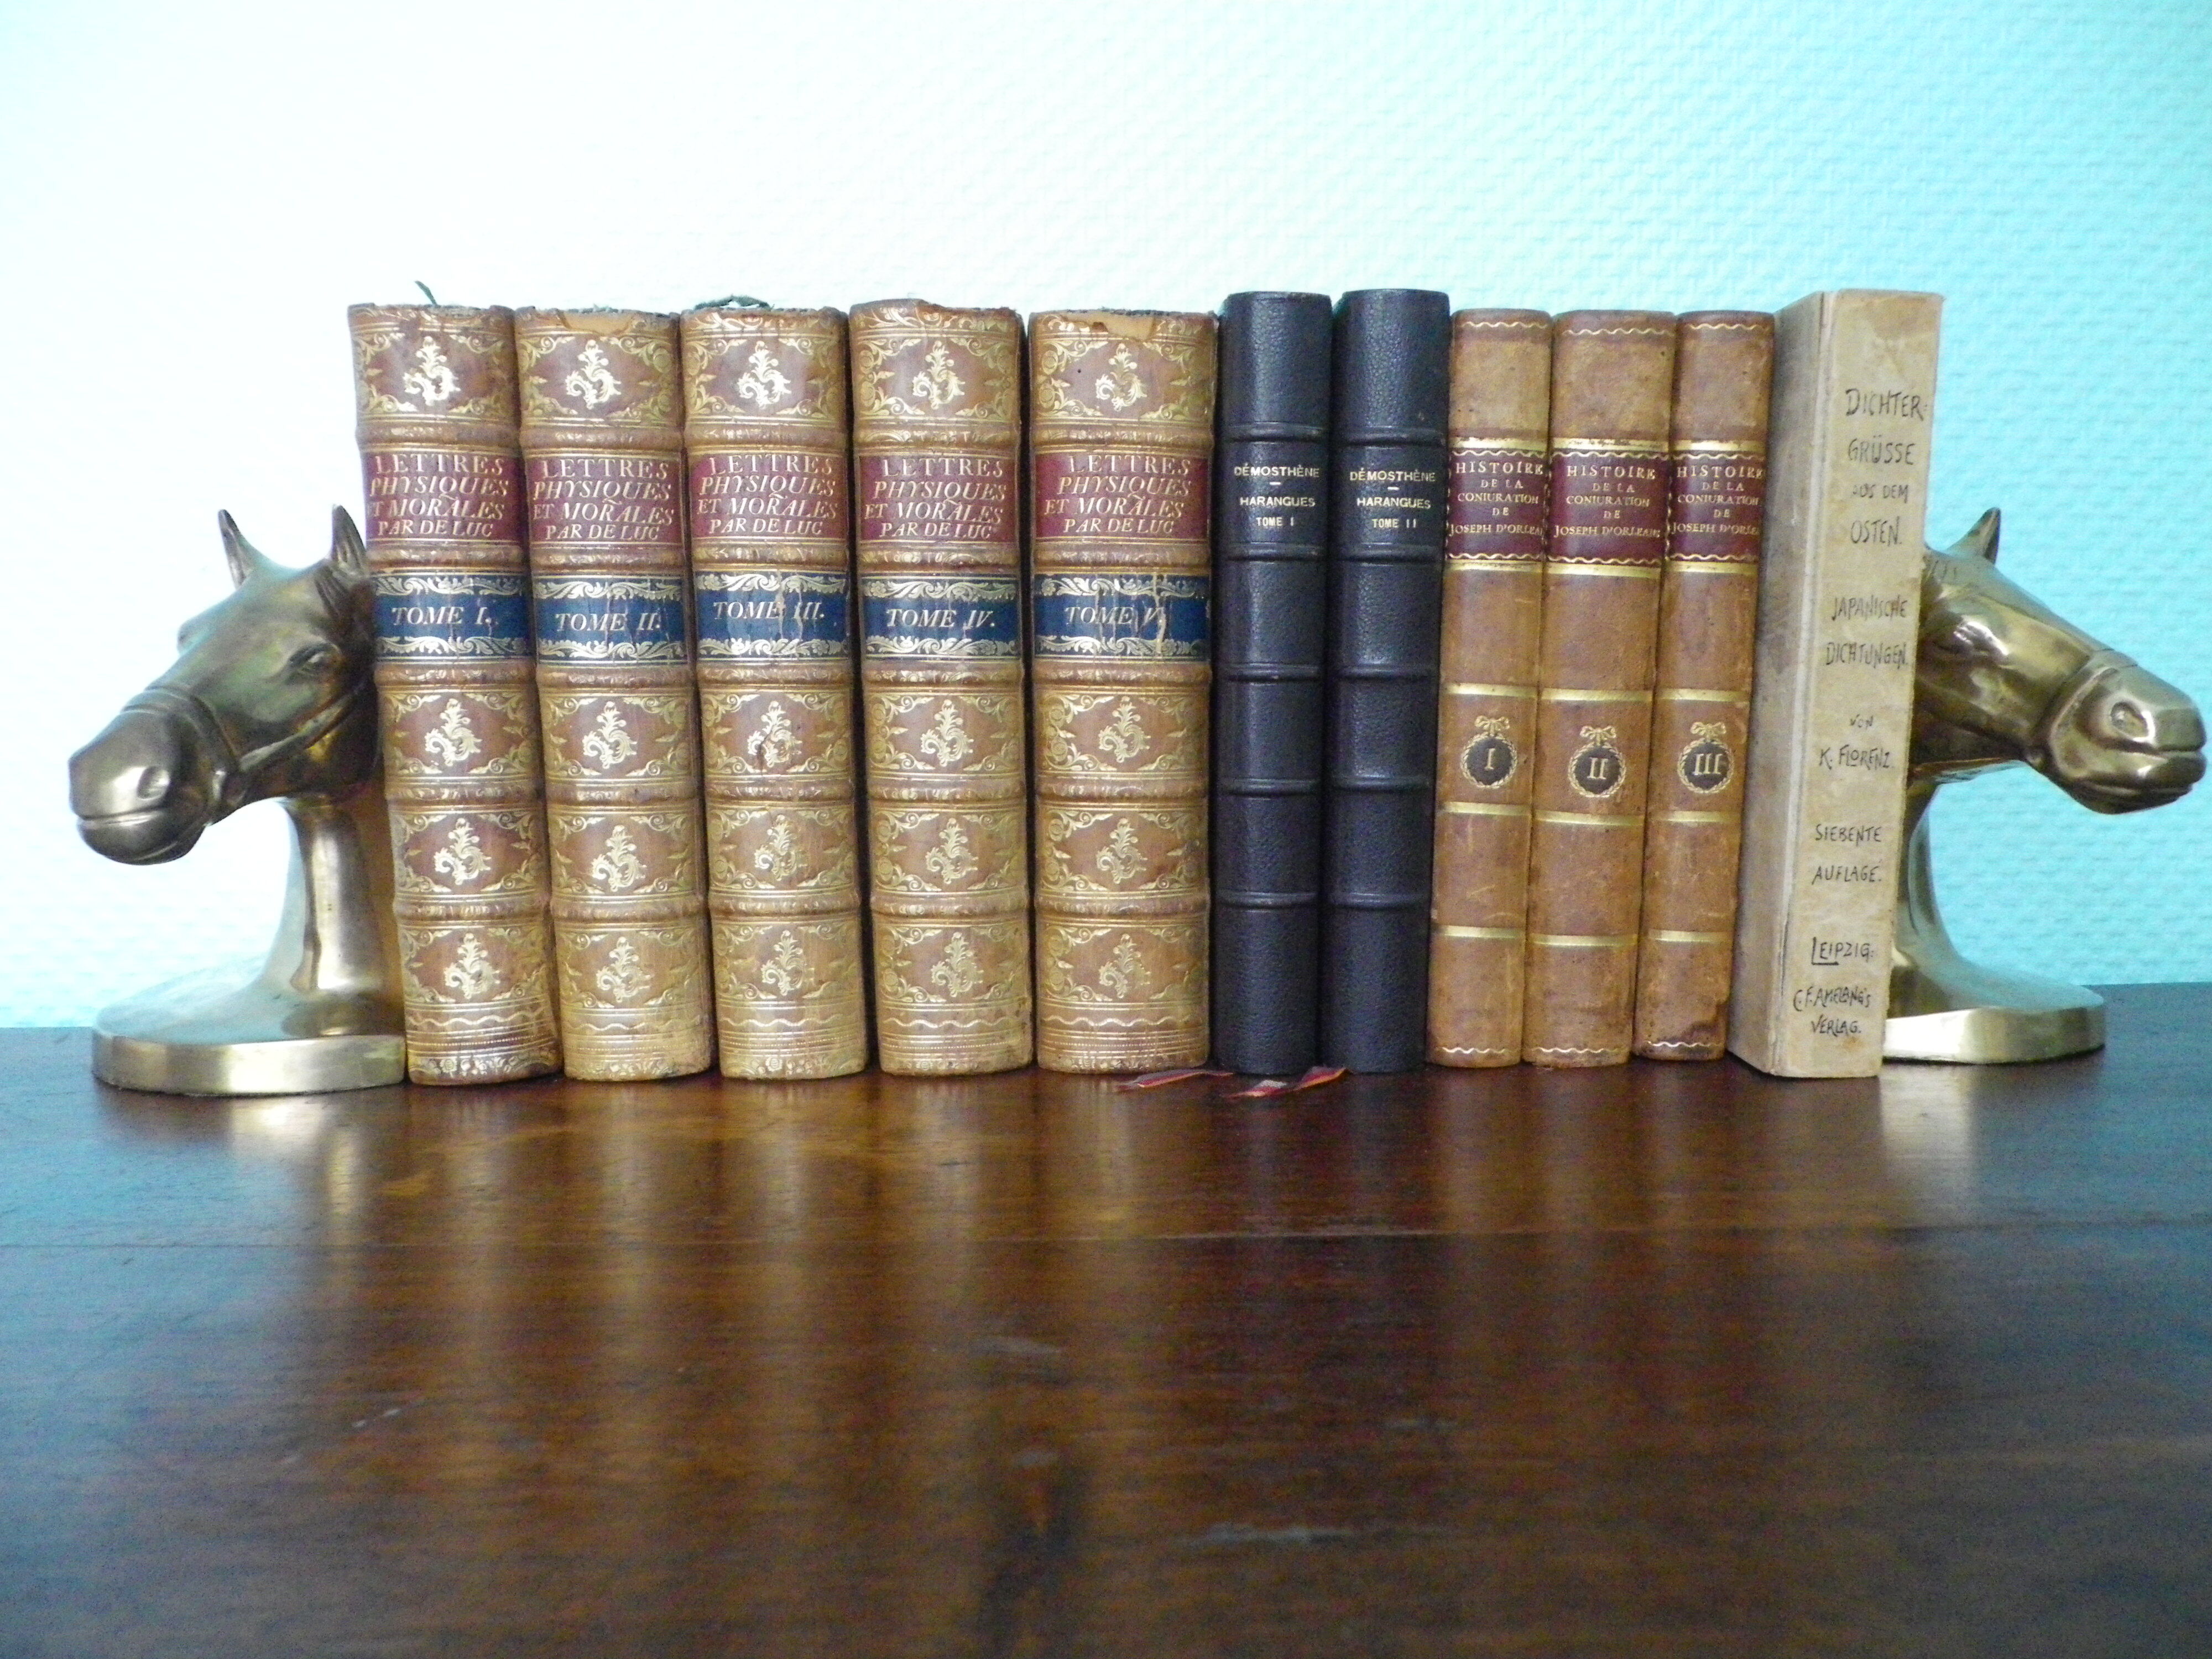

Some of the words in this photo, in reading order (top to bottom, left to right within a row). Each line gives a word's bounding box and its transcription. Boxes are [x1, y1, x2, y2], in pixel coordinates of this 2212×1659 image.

[1848, 435, 1915, 465] GRÜSSE
[375, 453, 503, 474] LETTRES
[542, 458, 669, 480] LETTRES
[709, 455, 833, 476] LETTRES
[882, 458, 1004, 478] LETTRES
[1069, 455, 1191, 476] LETTRES
[1234, 463, 1319, 478] DÉMOSTHÈNE
[1455, 461, 1543, 475] HISTOIRE
[1567, 465, 1655, 479] HISTOIRE
[1677, 465, 1764, 479] HISTOIRE
[1350, 467, 1436, 482] DÉMOSTHÈNE
[371, 476, 509, 500] PHYSIQUES
[533, 480, 671, 505] PHYSIQUES
[701, 476, 836, 499] PHYSIQUES
[872, 481, 1007, 505] PHYSIQUES
[1057, 476, 1191, 498] PHYSIQUES
[1480, 479, 1498, 488] DE
[1505, 479, 1524, 489] LA
[1593, 482, 1610, 491] DE
[1617, 483, 1635, 493] LA
[1702, 482, 1719, 491] DE
[1726, 482, 1744, 491] LA
[1240, 496, 1316, 507] HARANGUES
[1357, 497, 1431, 509] HARANGUES
[1458, 493, 1538, 504] CONIURATION
[1566, 495, 1650, 507] CONIURATION
[1677, 494, 1759, 505] CONIURATION
[1883, 484, 1908, 504] DEM
[389, 498, 504, 520] MORALES
[533, 503, 552, 520] ET
[561, 502, 675, 525] MORALES
[697, 498, 722, 515] ET
[729, 497, 837, 519] MORALES
[864, 503, 888, 519] ET
[896, 501, 1004, 524] MORALES
[1044, 499, 1069, 515] ET
[1073, 497, 1184, 519] MORALES
[1492, 507, 1510, 516] DE
[1603, 510, 1620, 518] DE
[1714, 509, 1730, 518] DE
[378, 520, 414, 536] PAR
[419, 520, 448, 535] DE
[452, 521, 493, 537] LUC
[709, 519, 747, 535] PAR
[752, 518, 780, 534] DE
[784, 519, 823, 535] LUC
[879, 522, 919, 538] PAR
[924, 522, 951, 536] DE
[954, 523, 992, 539] LUC
[1063, 518, 1101, 534] PAR
[1107, 518, 1134, 533] DE
[1137, 519, 1174, 534] LUC
[1256, 517, 1282, 526] TOME
[1290, 517, 1294, 526] I
[1373, 518, 1399, 529] TOME
[1406, 519, 1416, 528] II
[1449, 524, 1491, 536] JOSEPH
[1671, 522, 1715, 534] JOSEPH
[545, 525, 582, 541] PAR
[587, 524, 617, 539] DE
[618, 525, 660, 541] LUC
[1553, 525, 1597, 538] JOSEPH
[392, 607, 463, 626] TOME
[713, 602, 780, 620] TOME
[791, 602, 825, 620] III.
[1065, 607, 1134, 625] TOME
[1832, 595, 1908, 621] JAPANISCHE
[555, 613, 627, 632] TOME
[886, 609, 957, 628] TOME
[966, 609, 995, 628] IV.
[1484, 748, 1496, 770] I
[1693, 753, 1724, 776] III
[1819, 747, 1833, 770] K.
[1588, 757, 1608, 780] II
[1815, 823, 1882, 847] SIEBENTE
[1812, 865, 1881, 885] AUFLAGE.
[1811, 1014, 1861, 1037] VERLAG.
